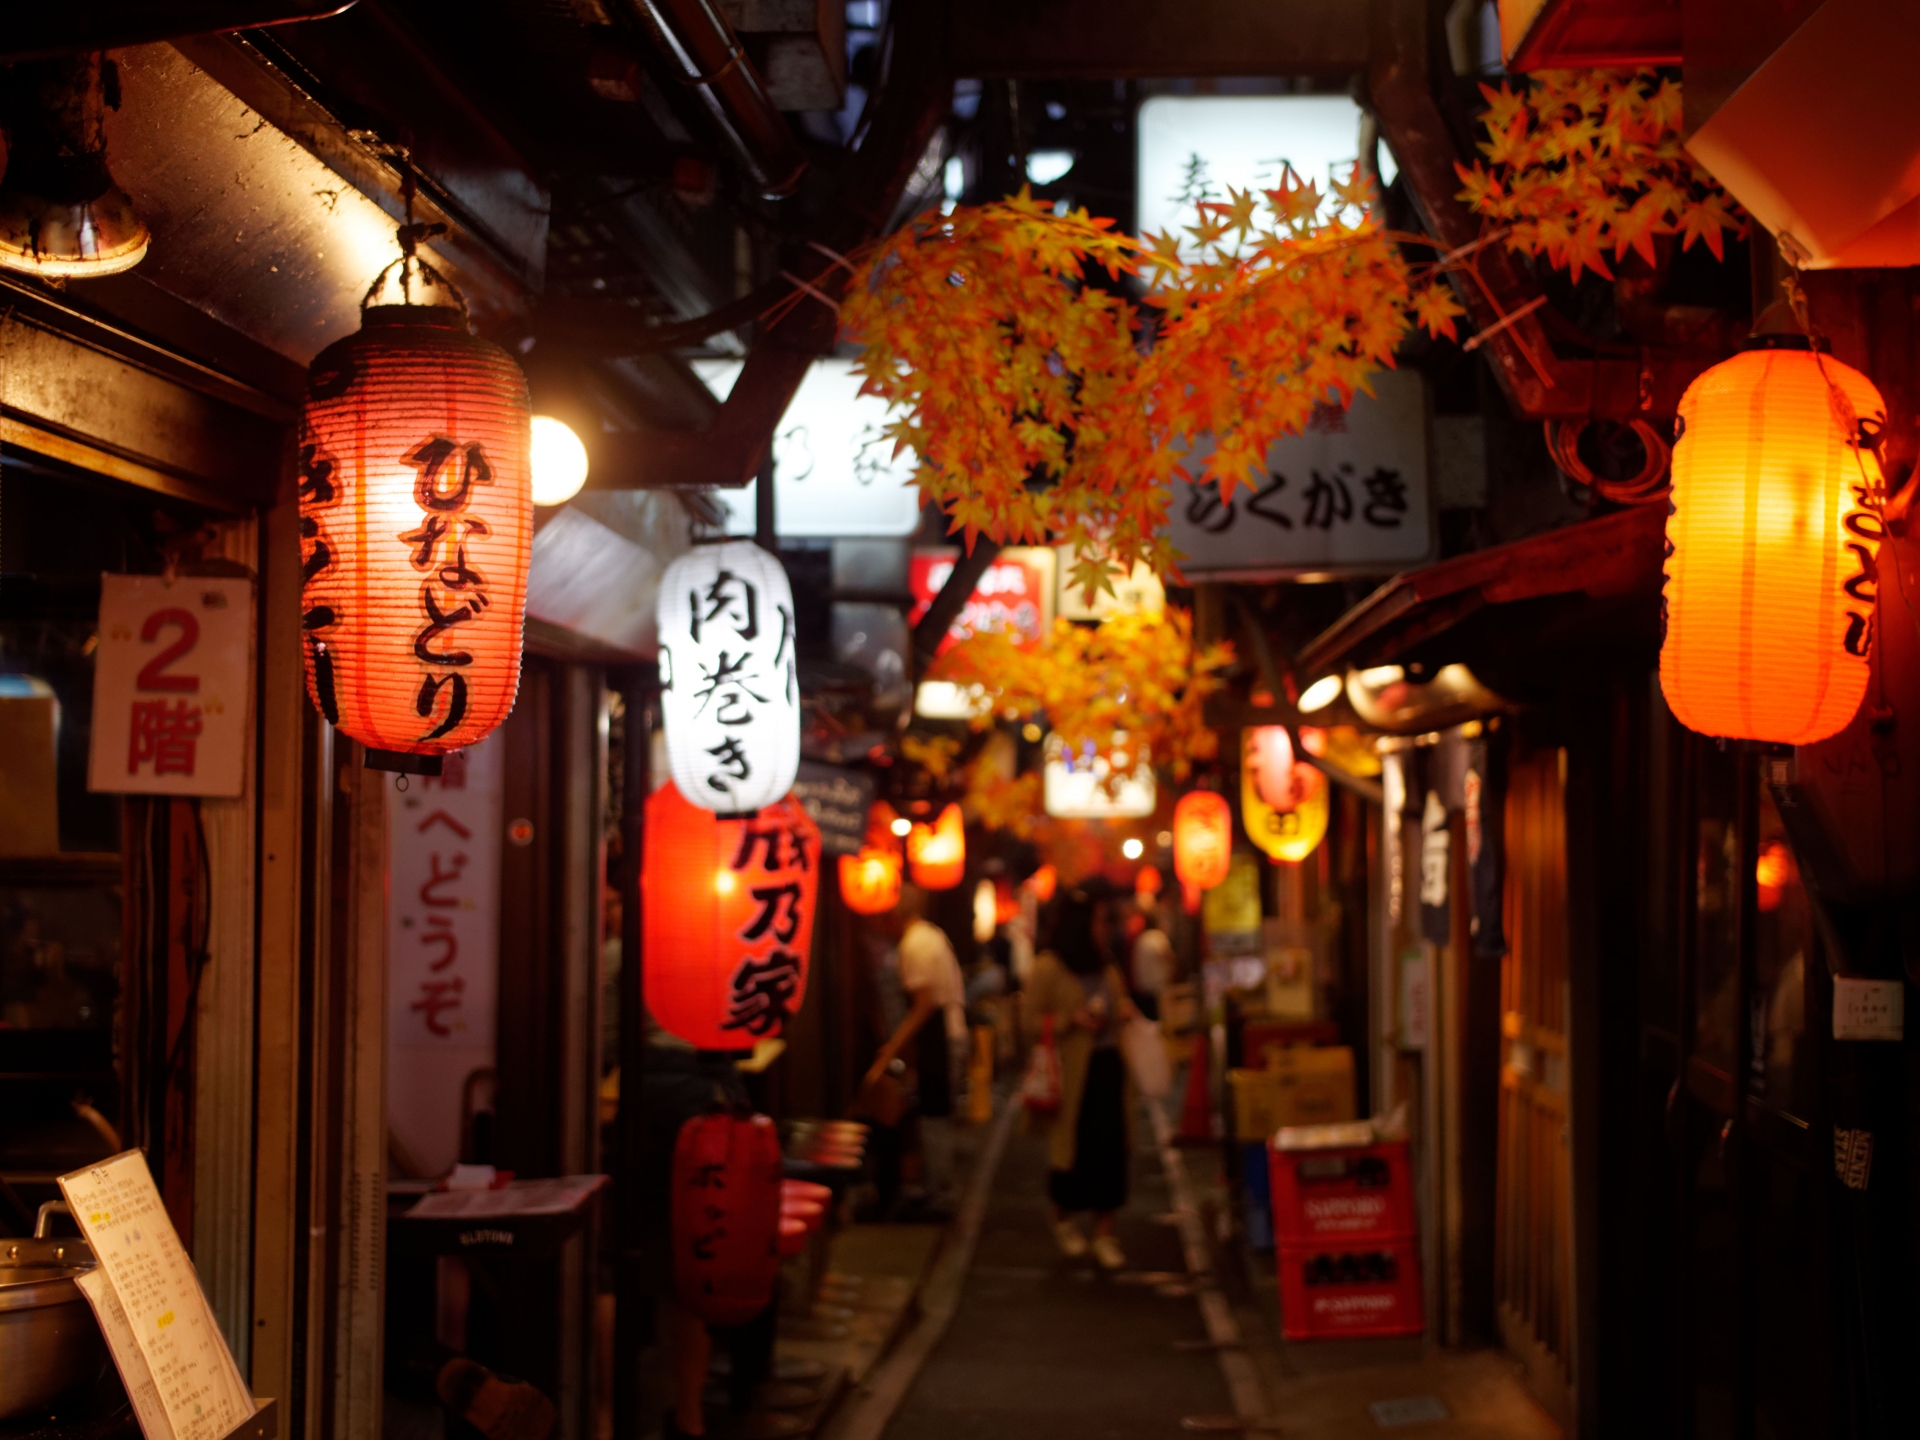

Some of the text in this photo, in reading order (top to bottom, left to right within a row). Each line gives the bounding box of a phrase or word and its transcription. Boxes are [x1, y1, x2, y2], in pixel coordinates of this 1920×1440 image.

[401, 434, 494, 742] ひなどり
[1187, 462, 1408, 533] らくがき
[128, 607, 203, 775] 2階
[690, 570, 770, 793] 肉巻き
